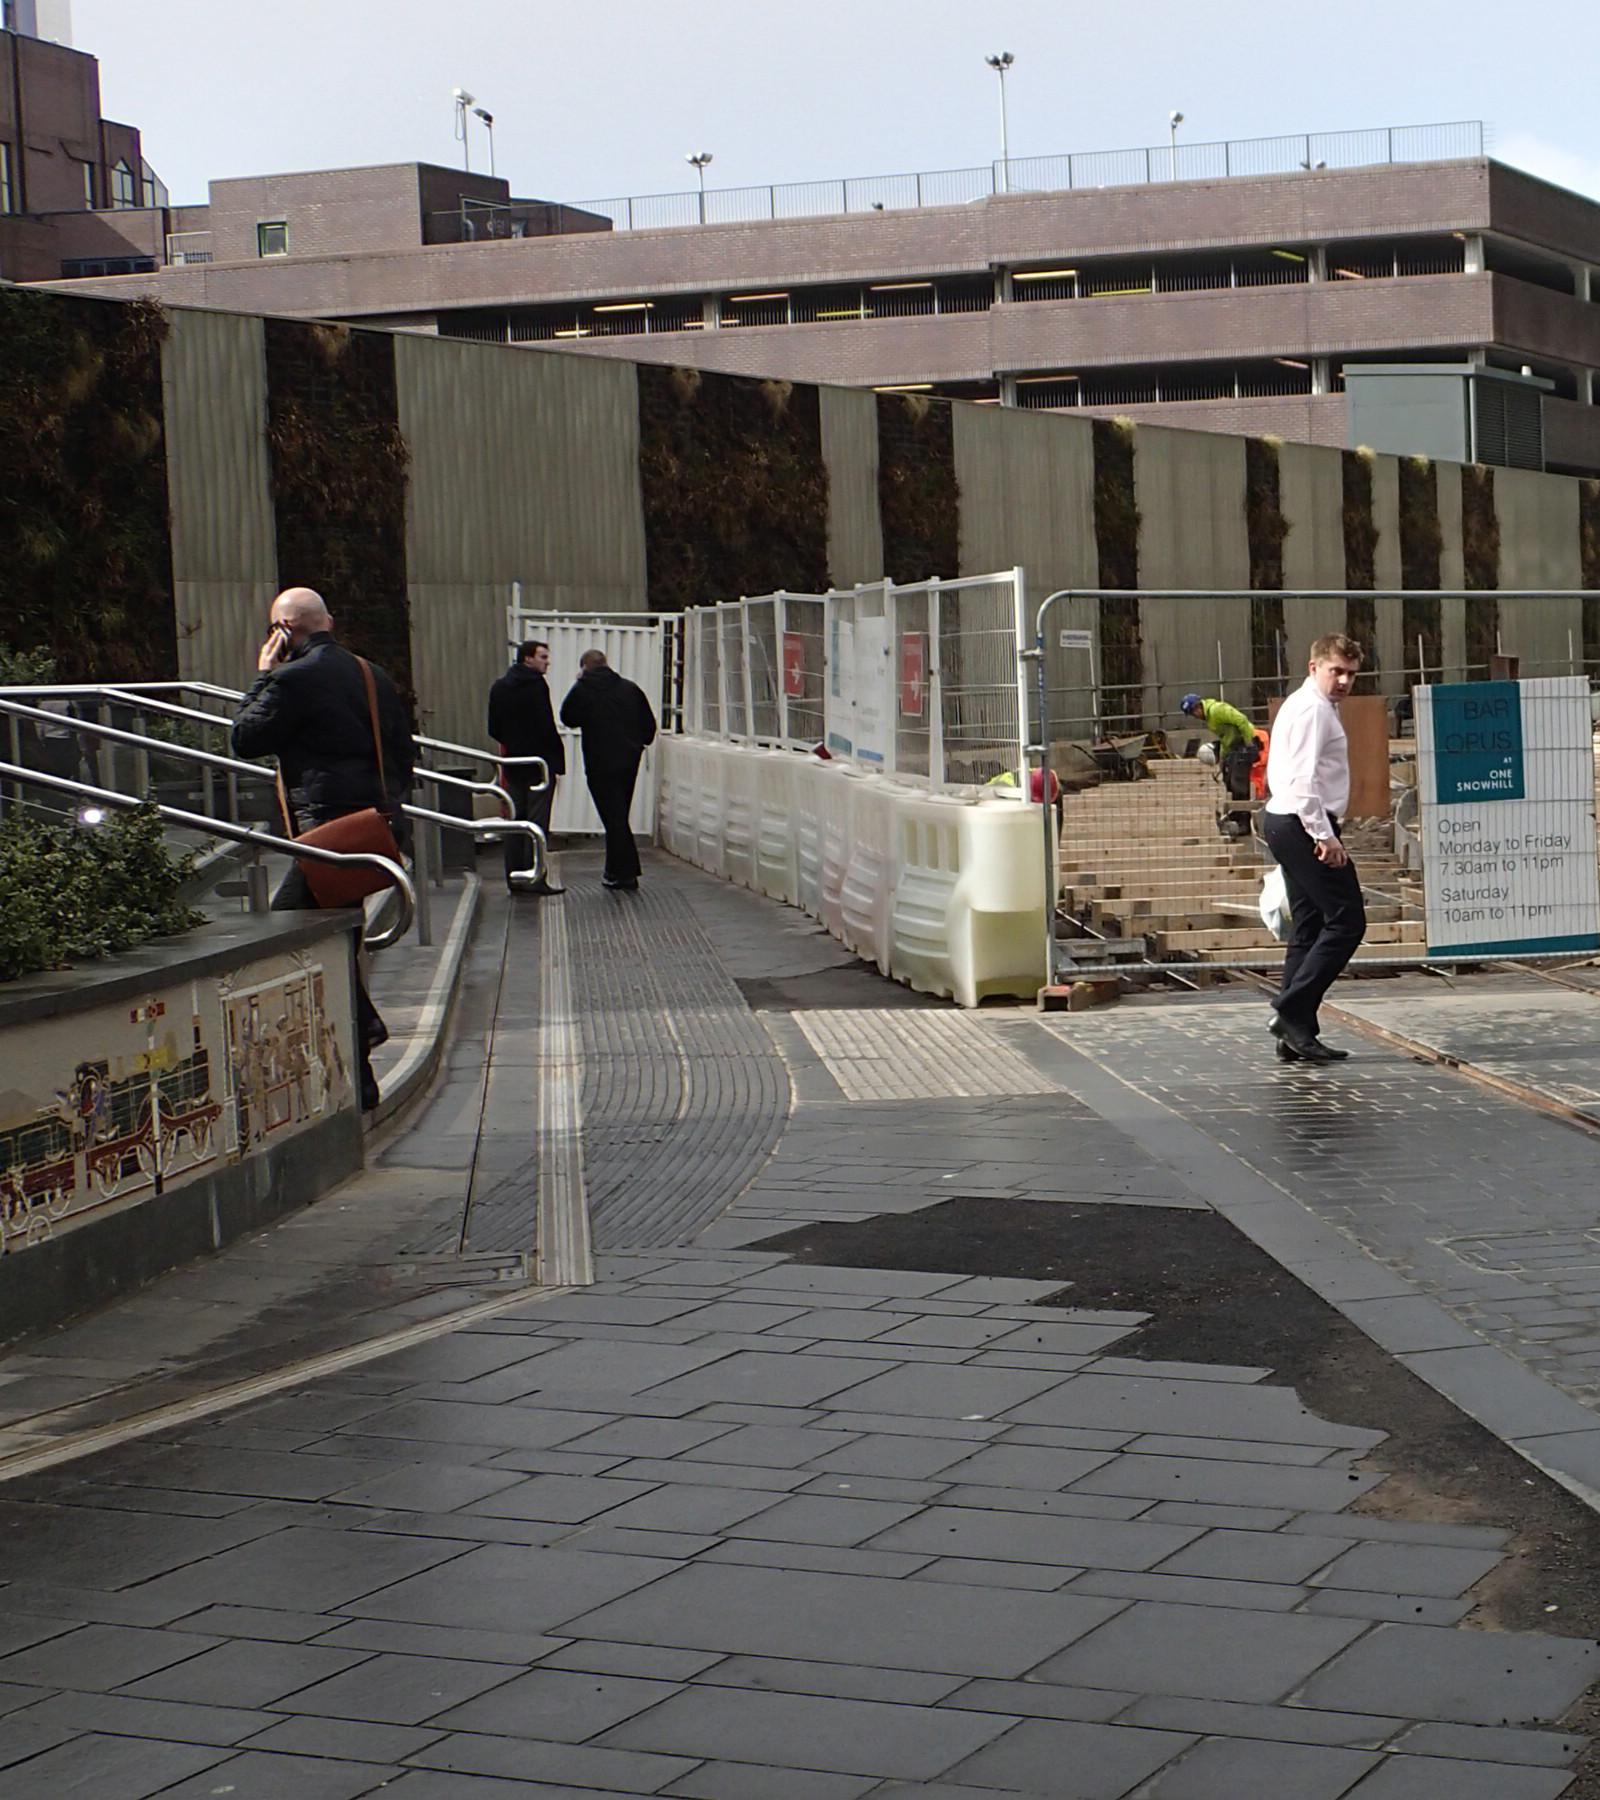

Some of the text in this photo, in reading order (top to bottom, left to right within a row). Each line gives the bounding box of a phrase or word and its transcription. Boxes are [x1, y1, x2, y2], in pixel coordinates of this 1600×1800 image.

[1464, 699, 1510, 720] BAR
[1445, 731, 1512, 754] OPUS
[1490, 769, 1513, 779] ONE
[1457, 780, 1514, 792] SNOWHILL
[1438, 819, 1481, 835] Open
[1439, 834, 1571, 855] Monday to Friday
[1440, 856, 1564, 876] 7.30am to 11pm
[1441, 886, 1509, 903] Saturday
[1444, 904, 1552, 923] 10am to 11pm
